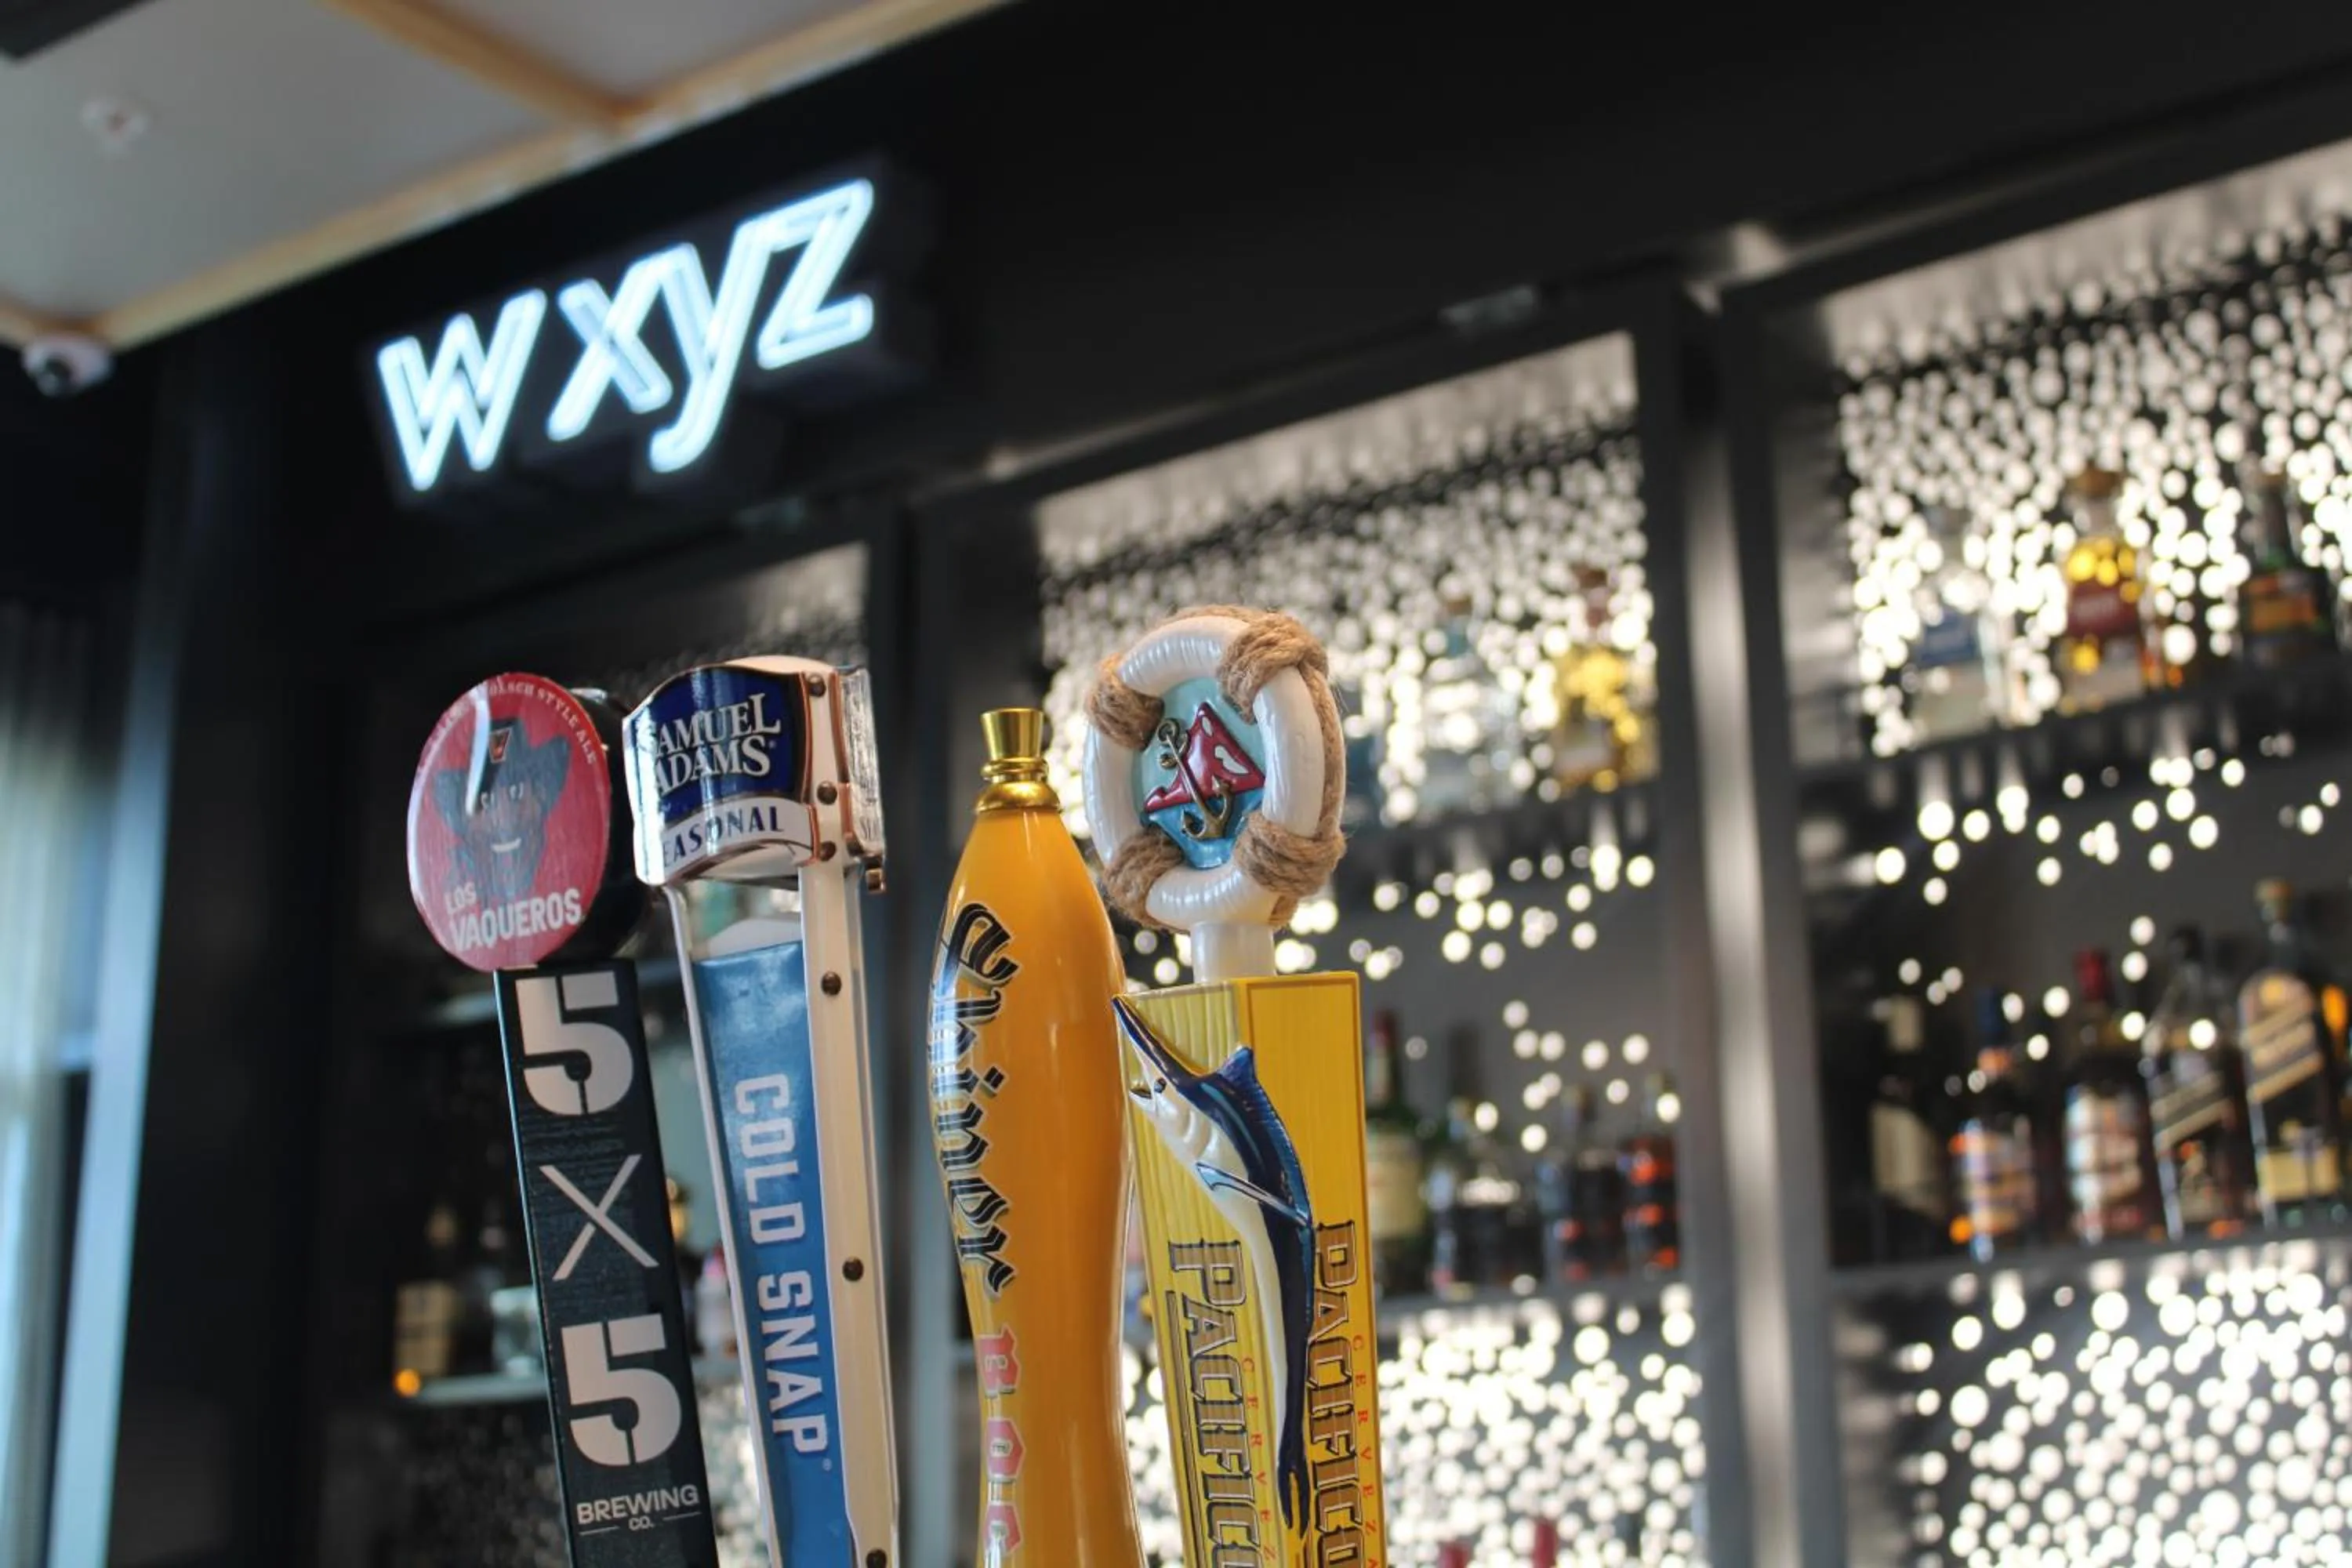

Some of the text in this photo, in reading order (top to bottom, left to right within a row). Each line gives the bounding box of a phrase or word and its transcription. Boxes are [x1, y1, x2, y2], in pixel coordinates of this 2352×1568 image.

[377, 177, 873, 492] wxyz
[488, 681, 597, 764] OLSCH STYLE ALE
[654, 692, 782, 757] AMUEL
[655, 735, 771, 797] ADAMS
[662, 806, 783, 868] EASONAL
[444, 881, 477, 916] LOS
[449, 887, 583, 953] VAQUEROS
[514, 971, 633, 1116] 5
[928, 902, 1021, 1294] Shiner
[735, 1072, 829, 1457] COLD SNAP
[561, 1312, 682, 1466] 5
[975, 1323, 1025, 1557] BOC
[1306, 1219, 1366, 1568] PACIFICO
[575, 1484, 701, 1525] BREWING
[1242, 1357, 1277, 1561] CERVEZ
[628, 1515, 655, 1531] CO.
